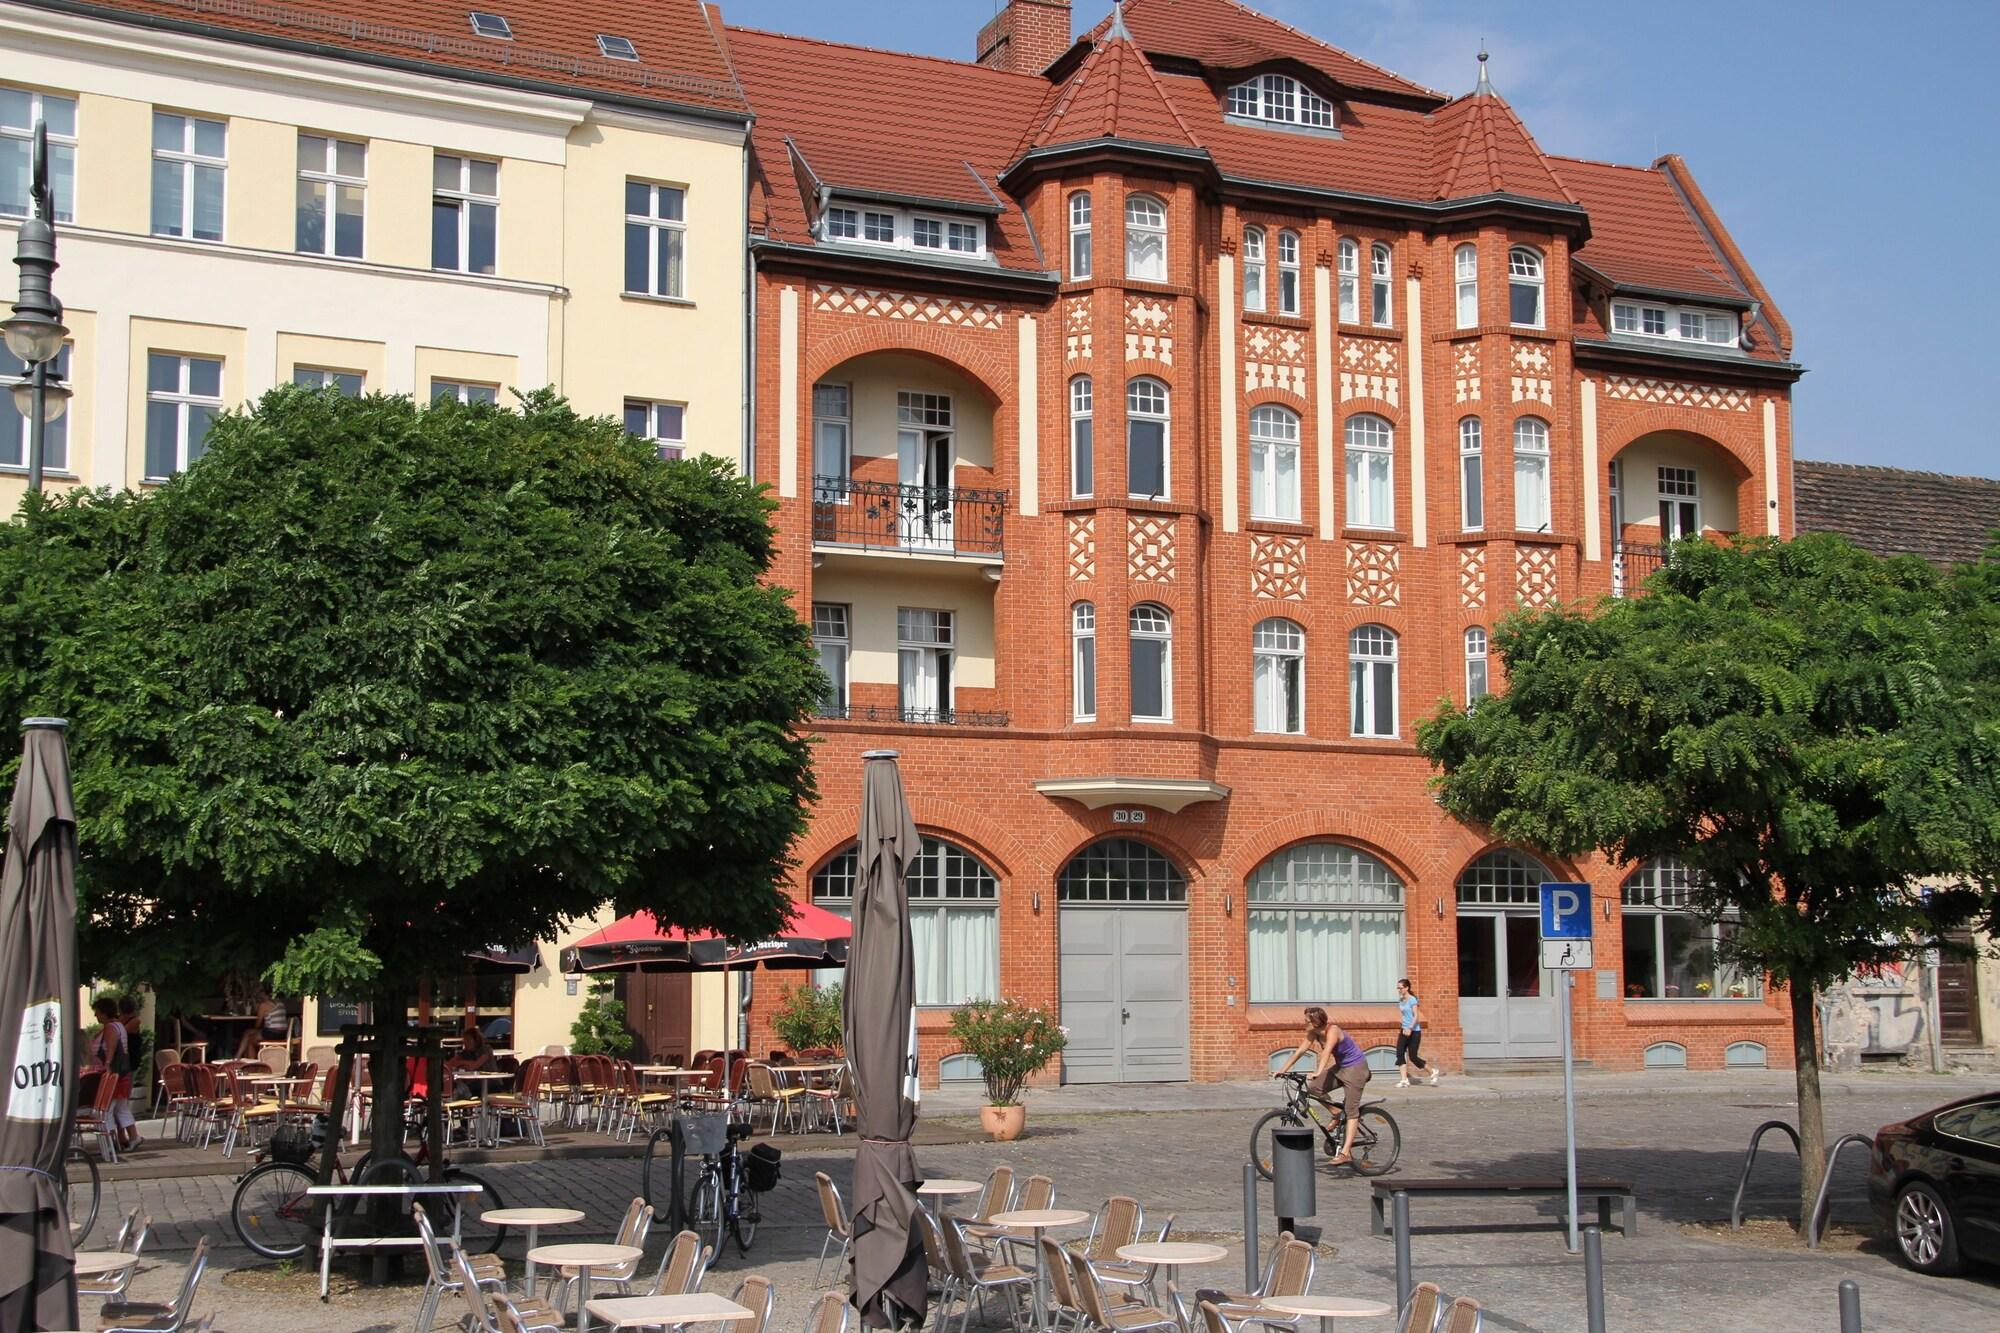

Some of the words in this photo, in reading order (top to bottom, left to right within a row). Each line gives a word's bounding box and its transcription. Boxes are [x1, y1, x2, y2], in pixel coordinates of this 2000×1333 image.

[1115, 811, 1126, 820] 30
[1132, 811, 1143, 821] 29
[1552, 890, 1579, 931] P
